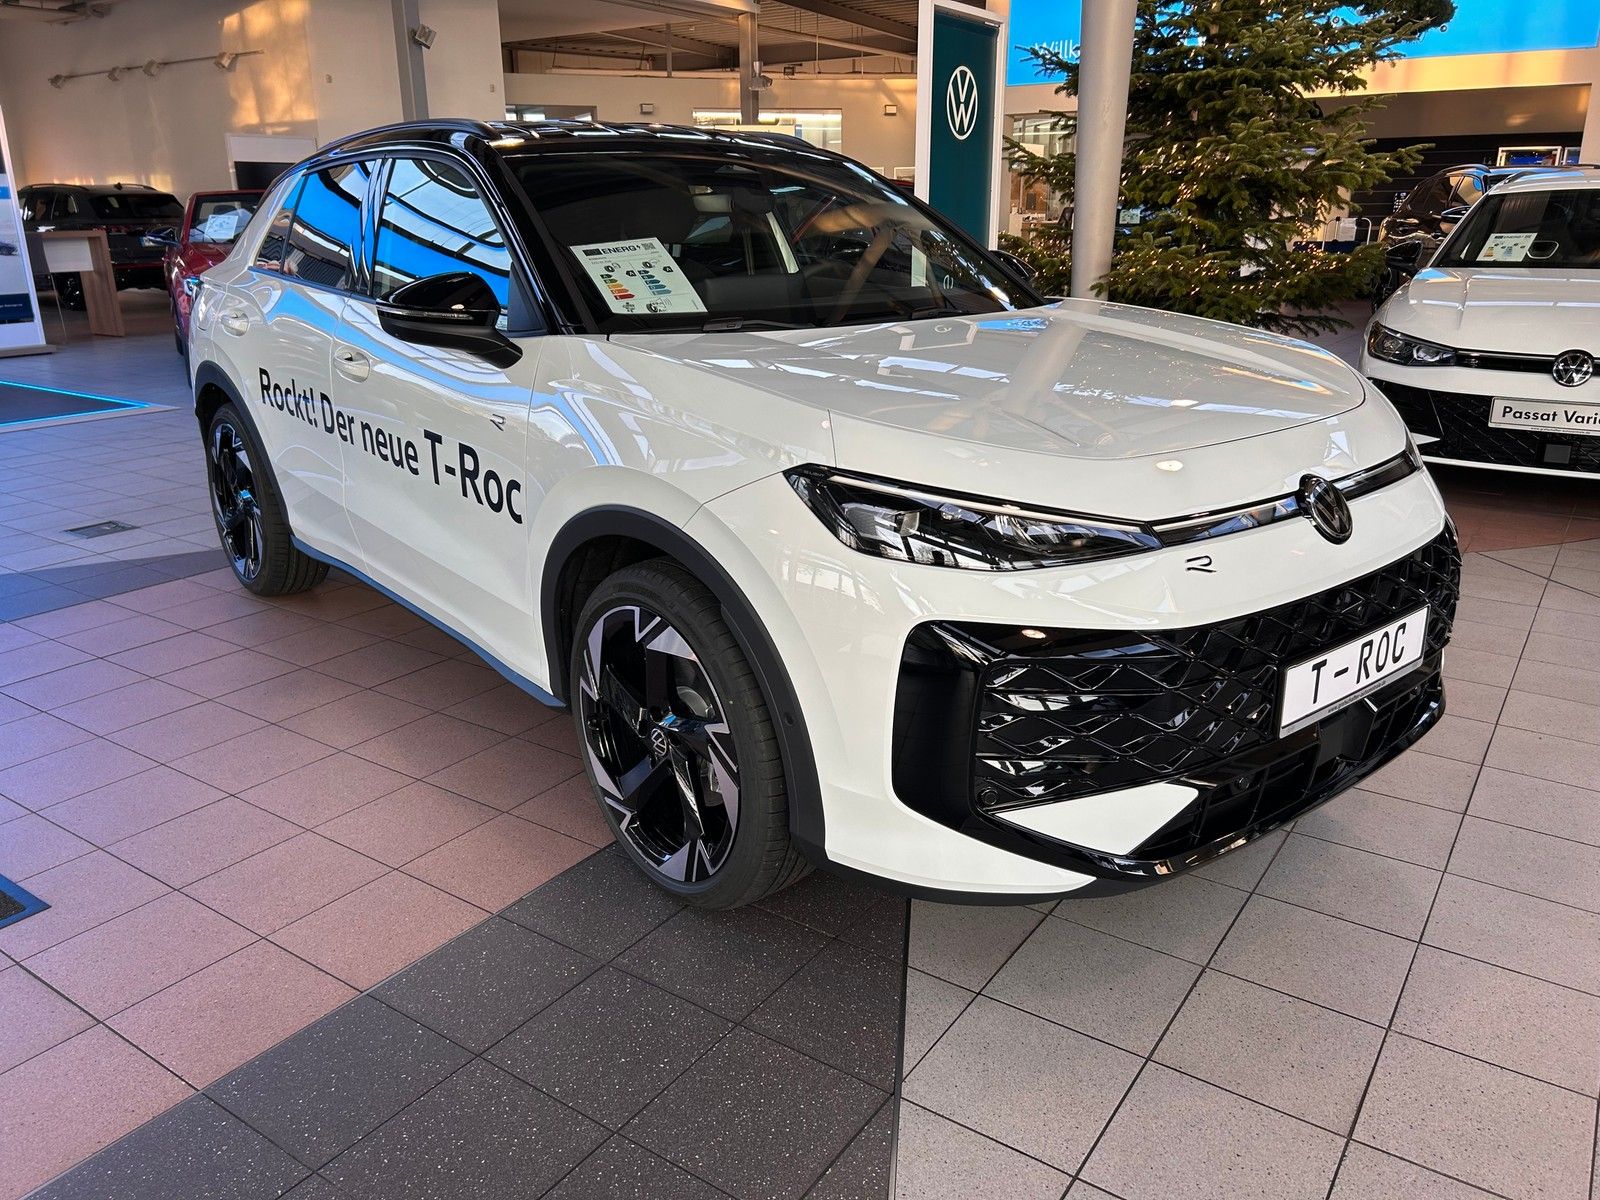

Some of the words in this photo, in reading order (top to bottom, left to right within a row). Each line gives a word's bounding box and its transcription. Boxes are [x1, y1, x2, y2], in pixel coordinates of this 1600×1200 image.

[946, 65, 978, 140] VW
[258, 367, 318, 428] Rockt!
[319, 391, 355, 446] Der
[360, 419, 420, 476] neue
[423, 428, 523, 525] T-Roc
[1502, 405, 1558, 422] Passat
[1563, 409, 1600, 425] Vari
